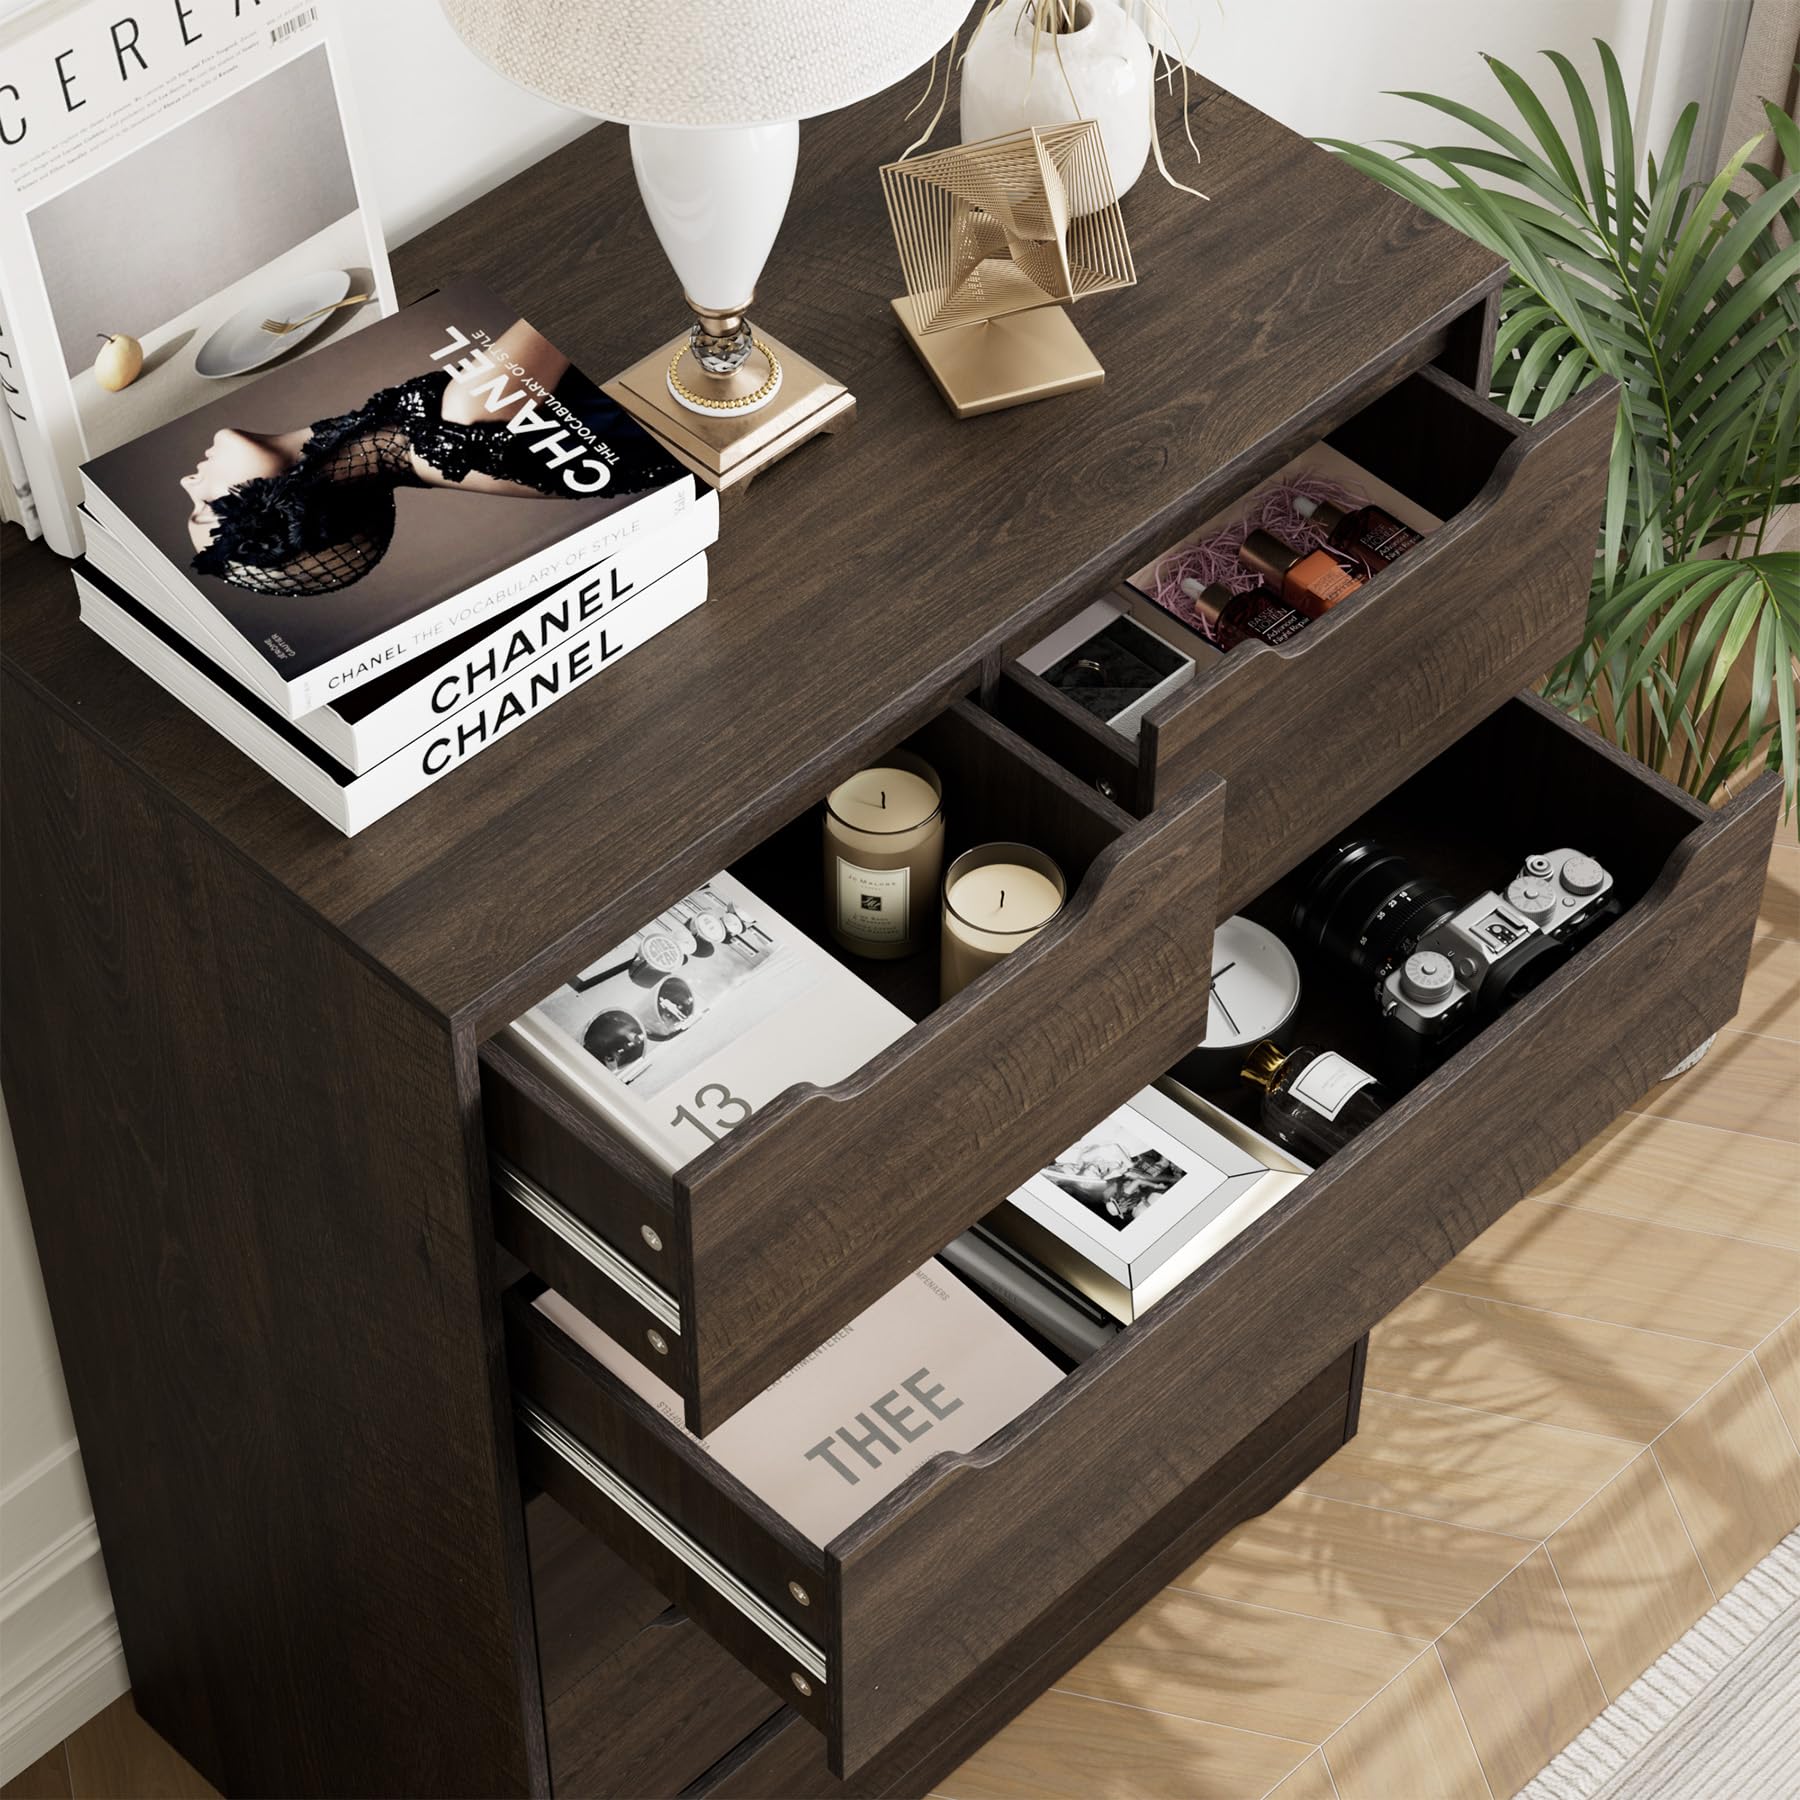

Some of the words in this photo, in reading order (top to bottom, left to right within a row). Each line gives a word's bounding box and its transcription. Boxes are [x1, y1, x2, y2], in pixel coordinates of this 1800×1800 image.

[0, 0, 261, 145] CERE
[471, 329, 510, 363] STYLE
[504, 360, 526, 378] OF
[429, 325, 611, 493] CHANEL
[520, 377, 597, 445] VOCABULARY
[593, 442, 621, 466] THE
[327, 643, 408, 690] CHANEL
[412, 623, 444, 646] THE
[447, 563, 560, 628] VOCABULARY
[564, 544, 588, 568] OF
[592, 519, 641, 554] STYLE
[431, 567, 634, 714] CHANEL
[422, 628, 624, 776] CHANEL
[1376, 911, 1386, 920] 35
[670, 1083, 753, 1144] 13
[803, 1367, 964, 1486] THEE
